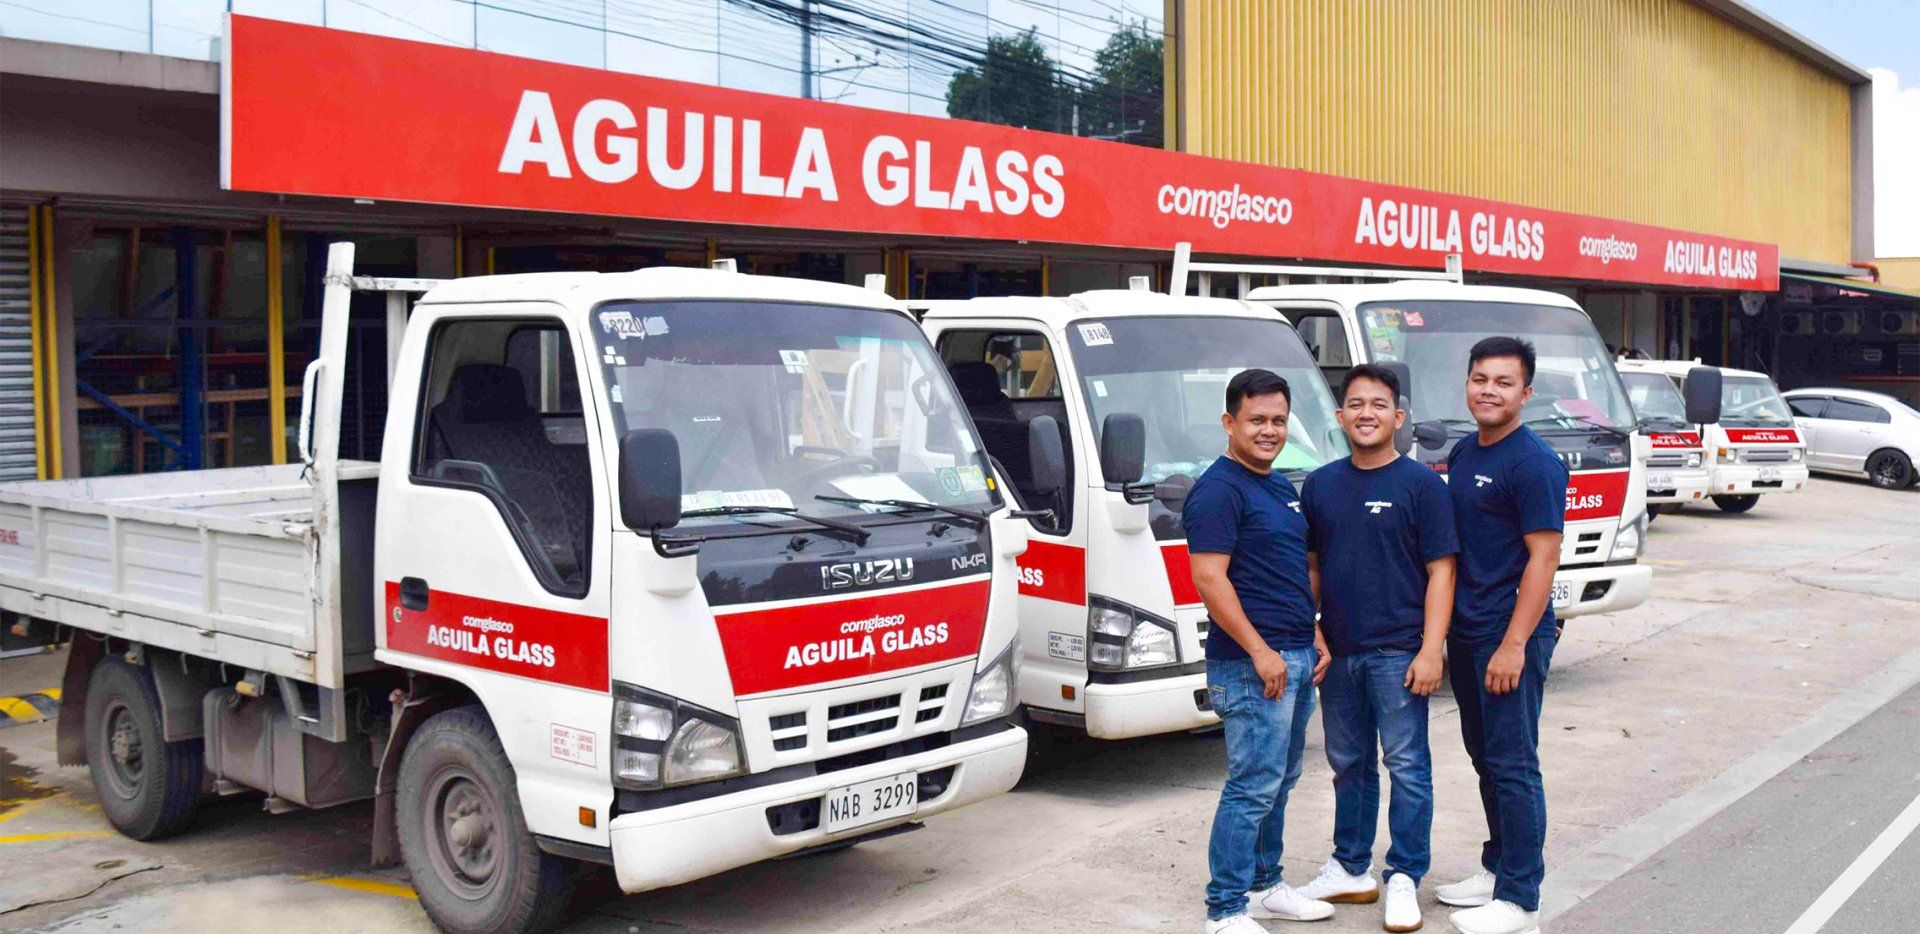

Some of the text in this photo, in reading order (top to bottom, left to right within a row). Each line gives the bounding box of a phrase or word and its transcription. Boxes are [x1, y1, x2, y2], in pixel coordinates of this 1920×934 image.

[498, 89, 1065, 219] AGUILA GLASS
[1157, 184, 1292, 229] comglasco
[1354, 197, 1544, 261] AGUILA GLASS
[1579, 234, 1637, 264] comglasco
[1664, 239, 1758, 280] AGUILA GLASS
[1564, 494, 1603, 511] GLASS
[821, 557, 914, 590] ISUZU
[951, 553, 987, 571] NKR
[1016, 565, 1044, 587] ASS
[1551, 585, 1569, 600] 526
[463, 614, 514, 633] comglasco
[840, 613, 905, 634] comglasco
[427, 624, 556, 667] AGUILA GLASS
[783, 622, 949, 669] AGUILA GLASS
[830, 781, 915, 823] NAB 3299
